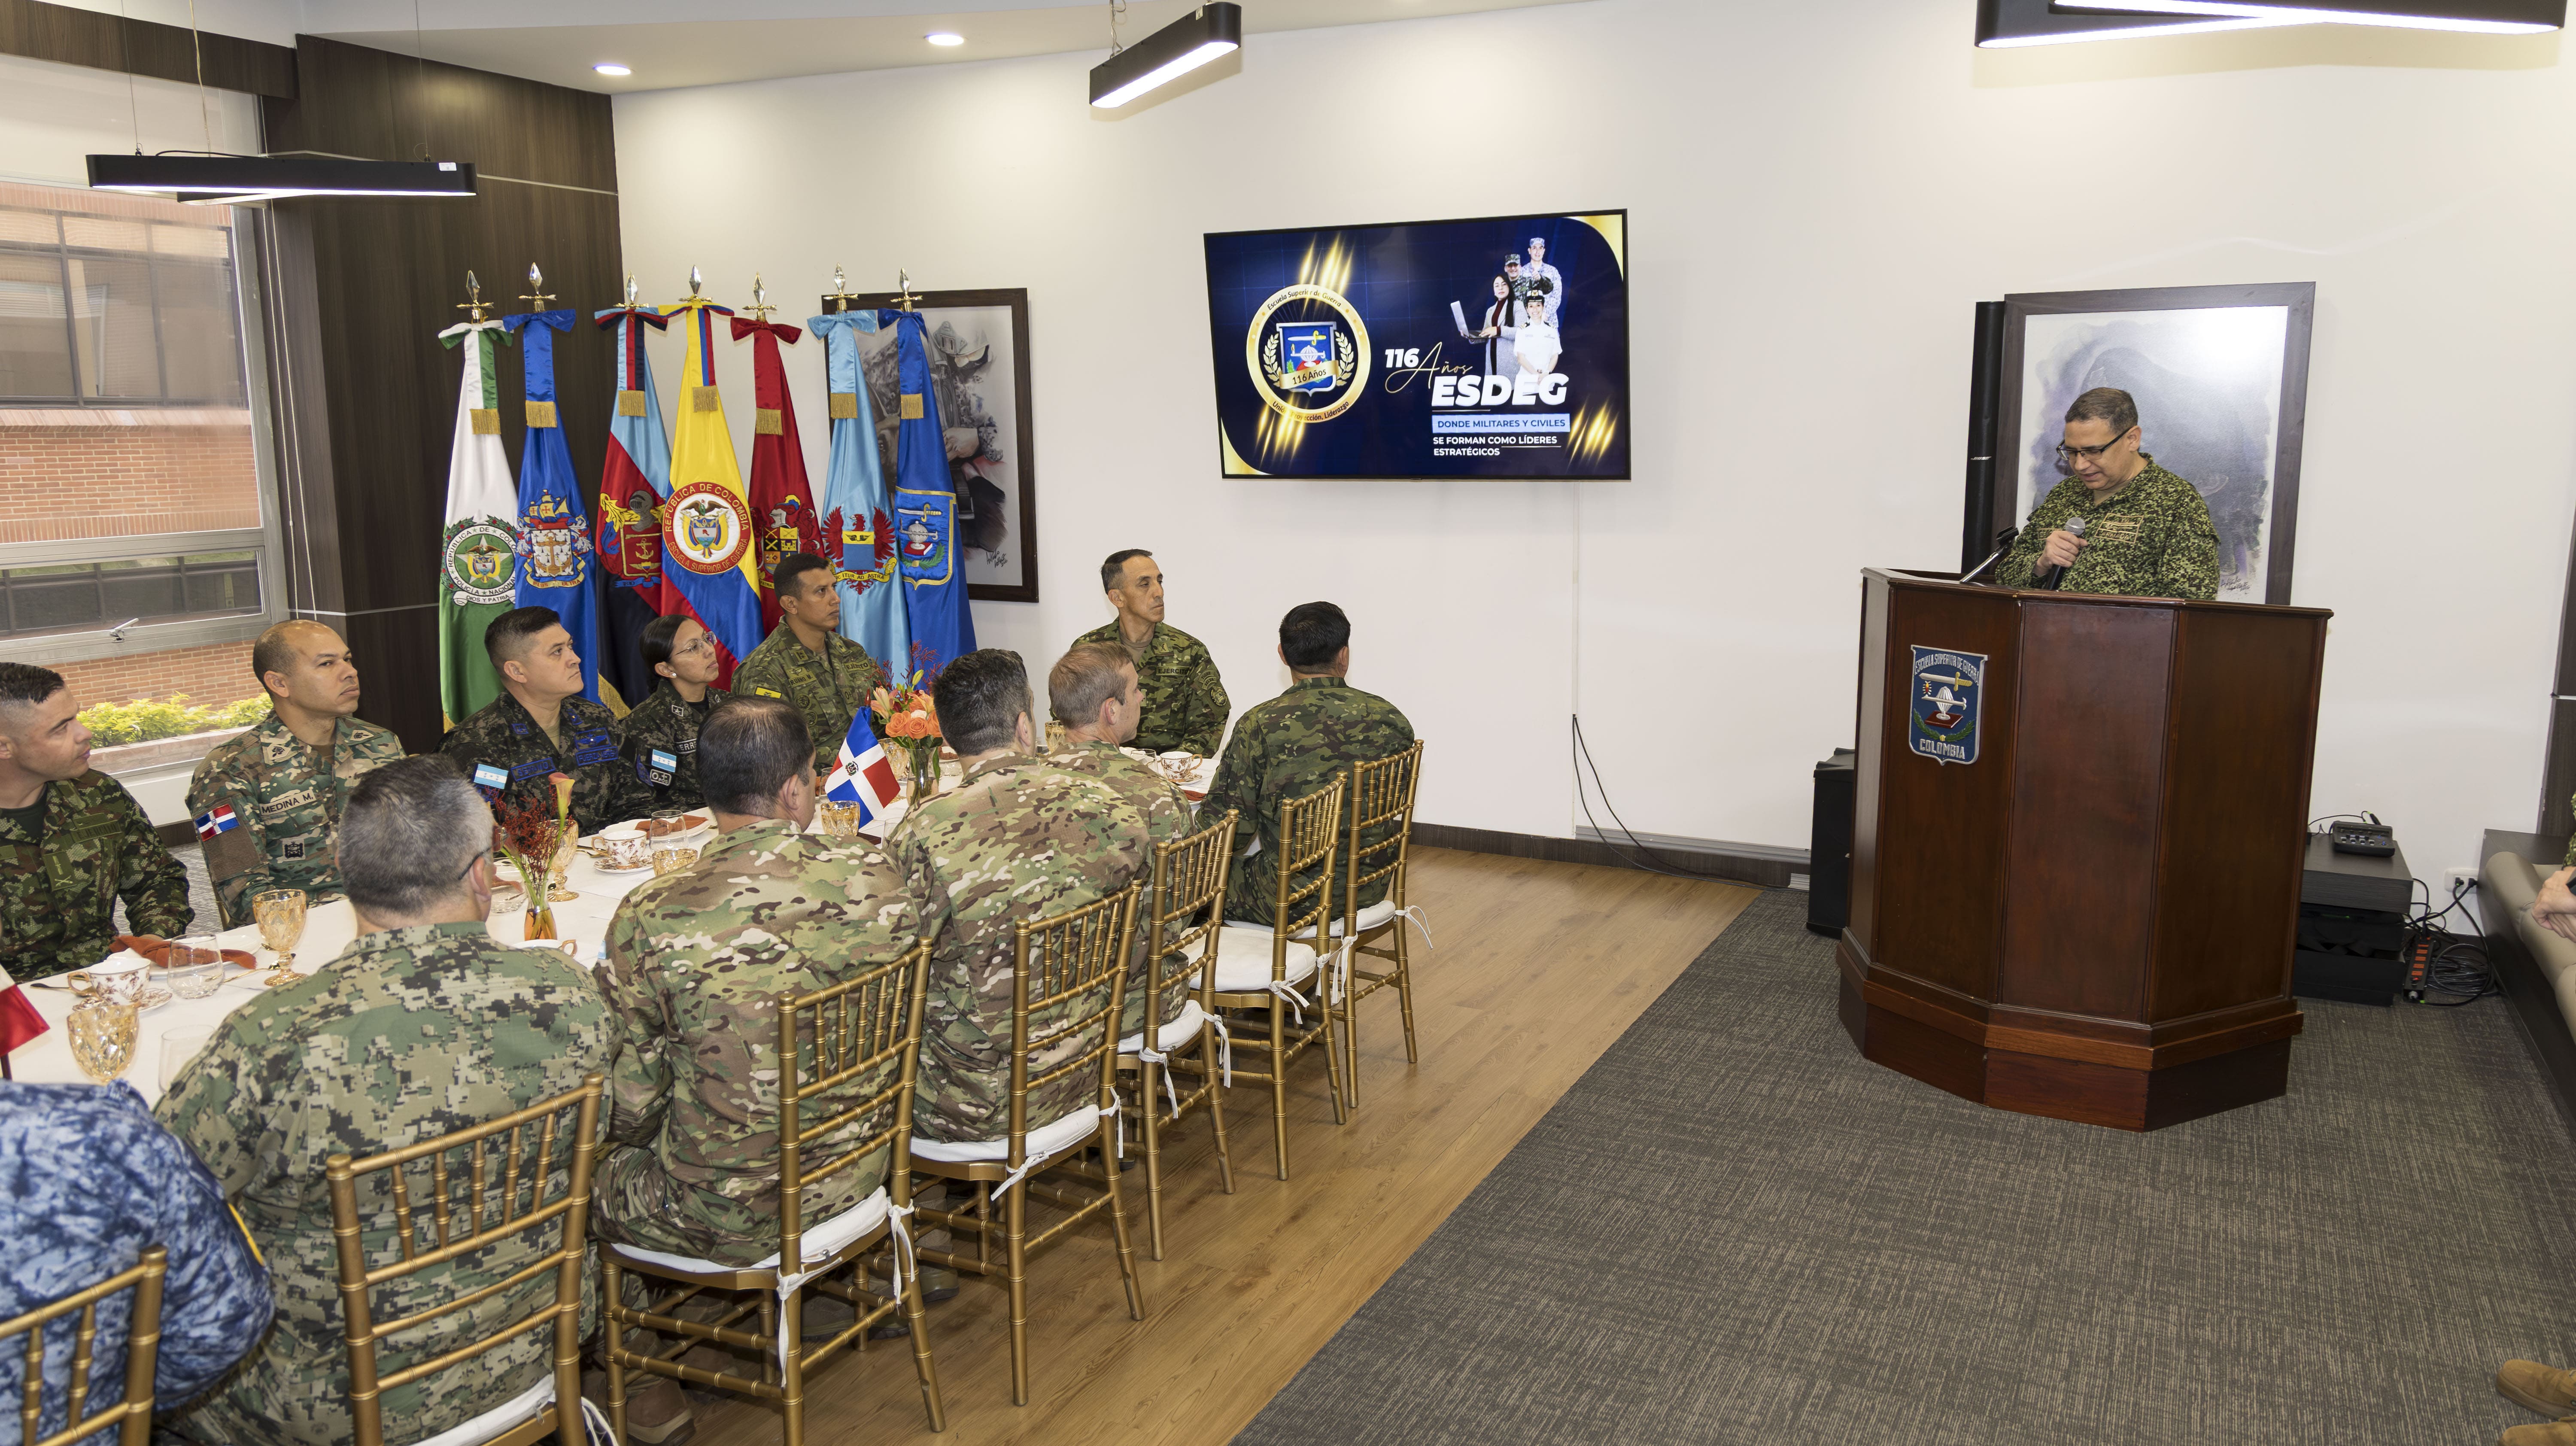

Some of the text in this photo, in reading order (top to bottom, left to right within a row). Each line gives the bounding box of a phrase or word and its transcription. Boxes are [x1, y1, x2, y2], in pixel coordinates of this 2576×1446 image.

[1267, 294, 1287, 310] Escuela
[1322, 292, 1342, 307] Guerra
[1292, 369, 1327, 385] 116 Años
[1385, 341, 1473, 393] 116 Años
[1431, 373, 1569, 407] ESDEG
[1273, 401, 1287, 413] Unió
[1324, 401, 1349, 419] Liderazgo
[1519, 434, 1557, 444] LÍDERES
[1434, 447, 1500, 456] ESTRATÉGICOS
[699, 483, 713, 492] DE
[714, 486, 749, 531] COLOMBIA
[499, 533, 516, 554] COLO
[668, 539, 748, 573] ESCUELA SUPERIOR DE GUERRA
[1914, 653, 1979, 686] ESCUELA SUPERIOR DE GUERRA
[1920, 738, 1965, 759] COLOMBIA
[261, 793, 313, 813] MEDINA M.
